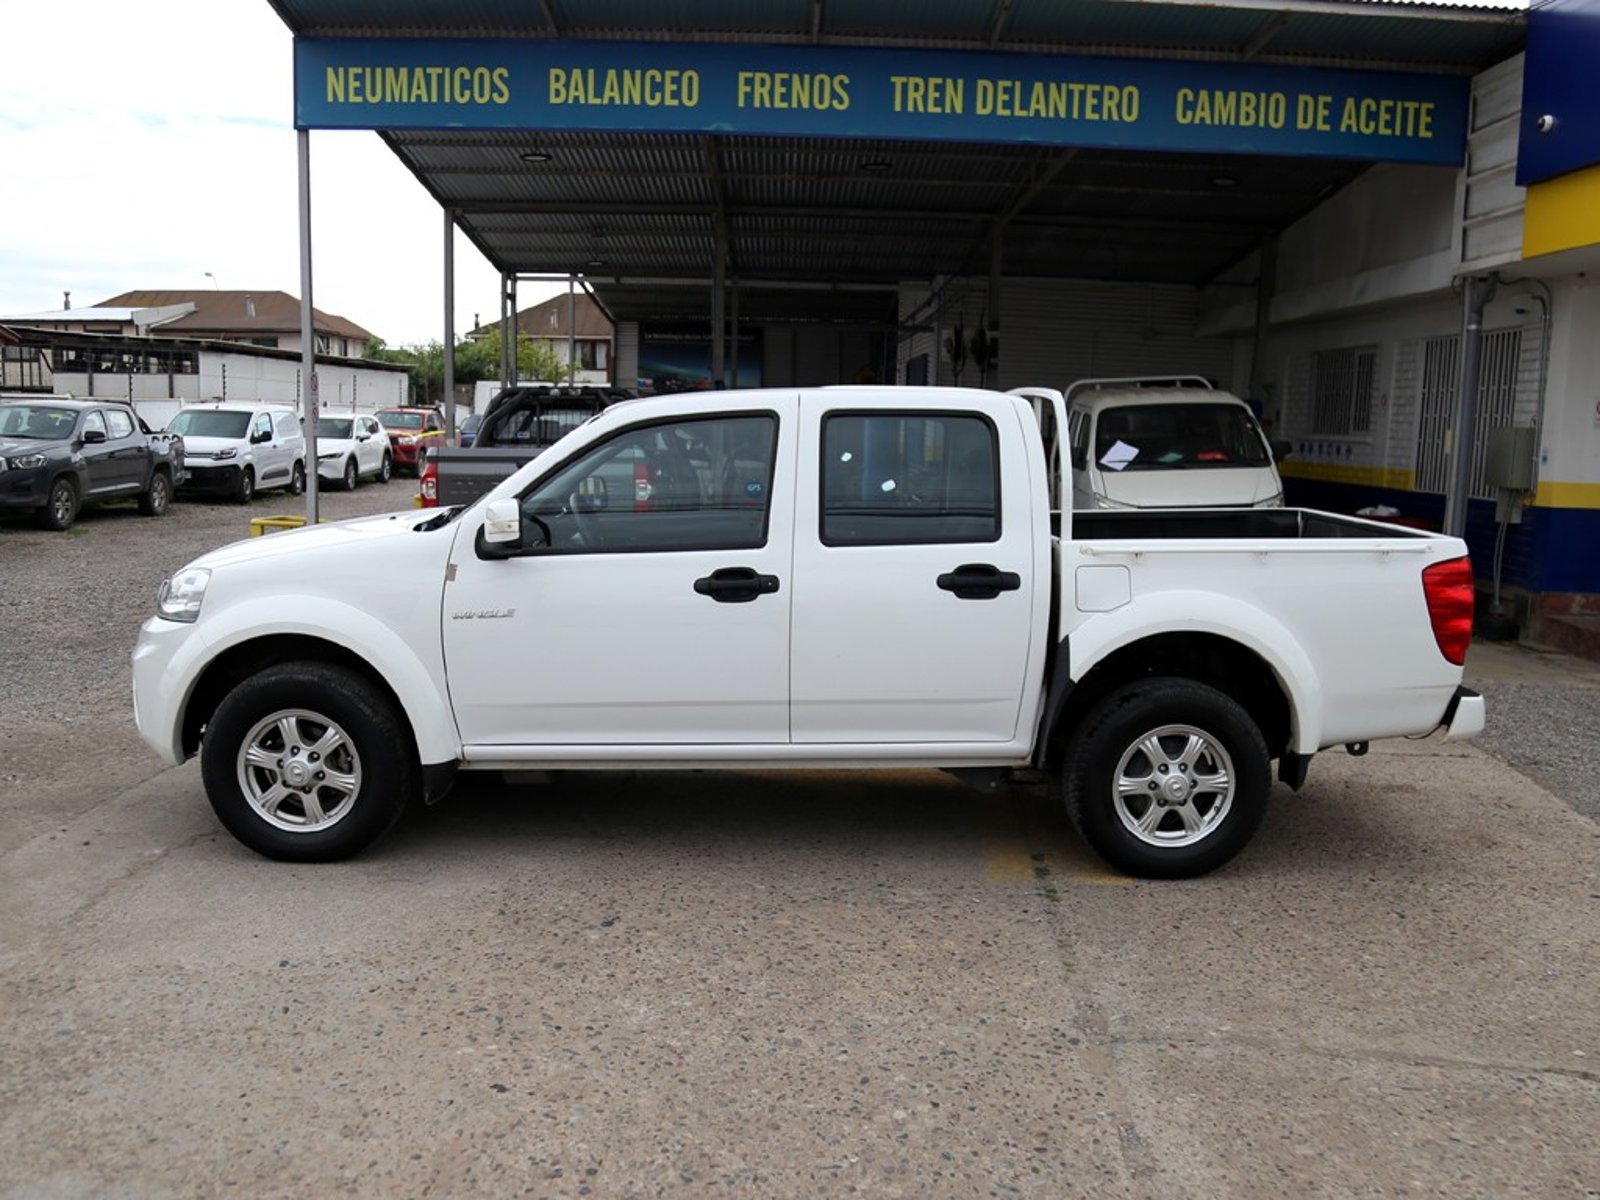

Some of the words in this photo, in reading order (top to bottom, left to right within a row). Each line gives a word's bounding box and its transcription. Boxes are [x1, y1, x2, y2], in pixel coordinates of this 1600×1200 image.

[326, 67, 510, 104] NEUMATICOS
[549, 68, 699, 107] BALANCEO
[737, 71, 850, 111] FRENOS
[891, 76, 964, 113] TREN
[976, 80, 1139, 123] DELANTERO
[1176, 88, 1286, 129] CAMBIO
[1297, 94, 1332, 131] DE
[1340, 98, 1435, 138] ACEITE
